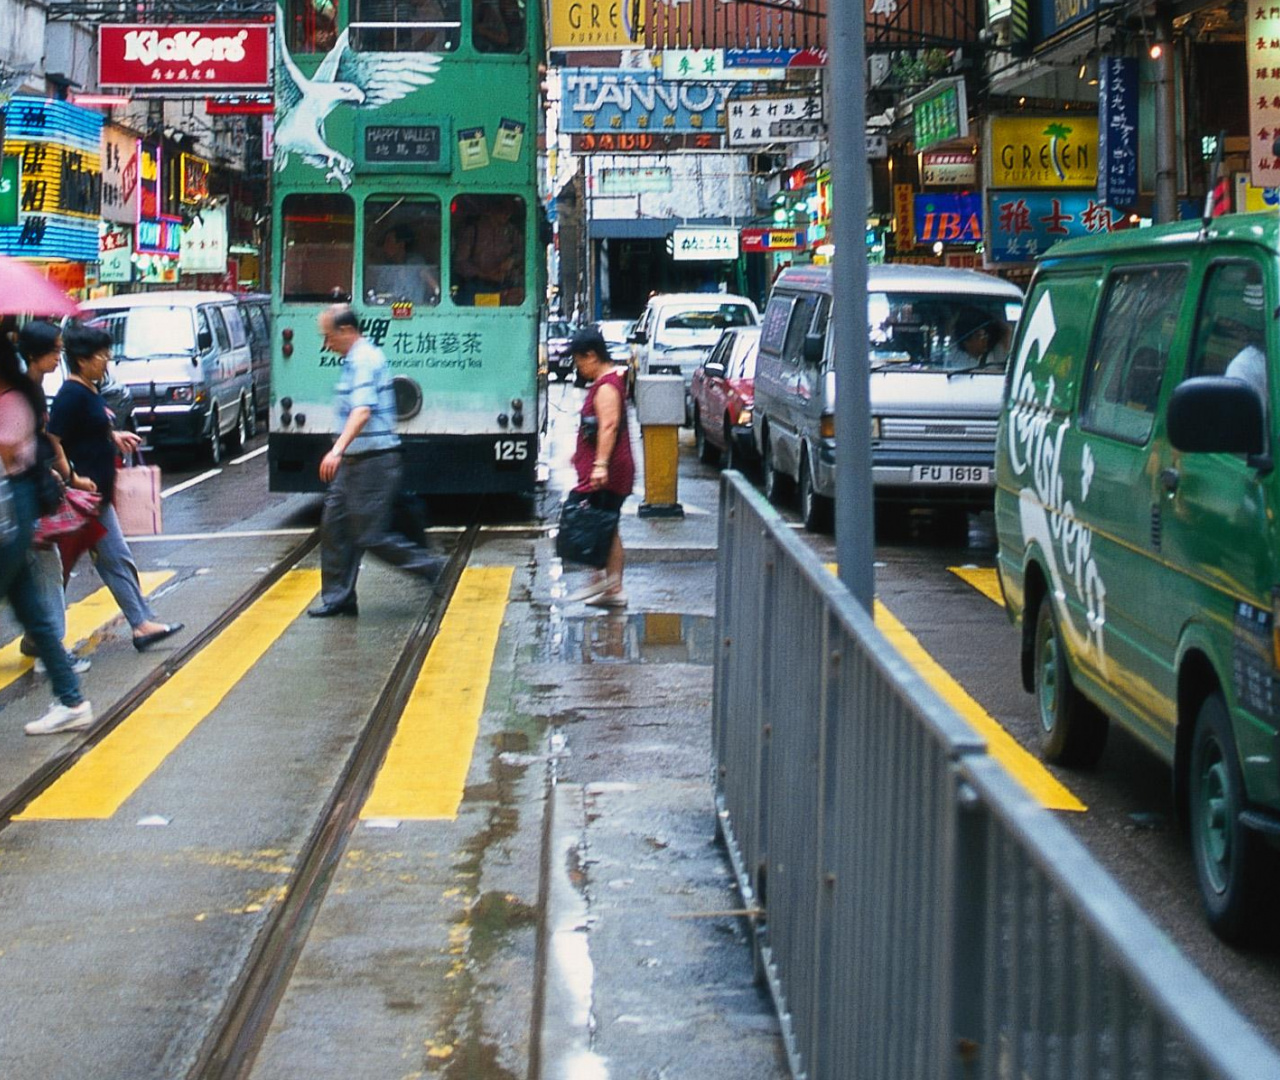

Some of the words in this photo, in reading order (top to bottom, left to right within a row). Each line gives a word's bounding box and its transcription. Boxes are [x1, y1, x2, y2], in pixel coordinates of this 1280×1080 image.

[367, 127, 399, 143] HAPPY
[402, 127, 437, 143] VALLEY
[494, 441, 528, 461] 125
